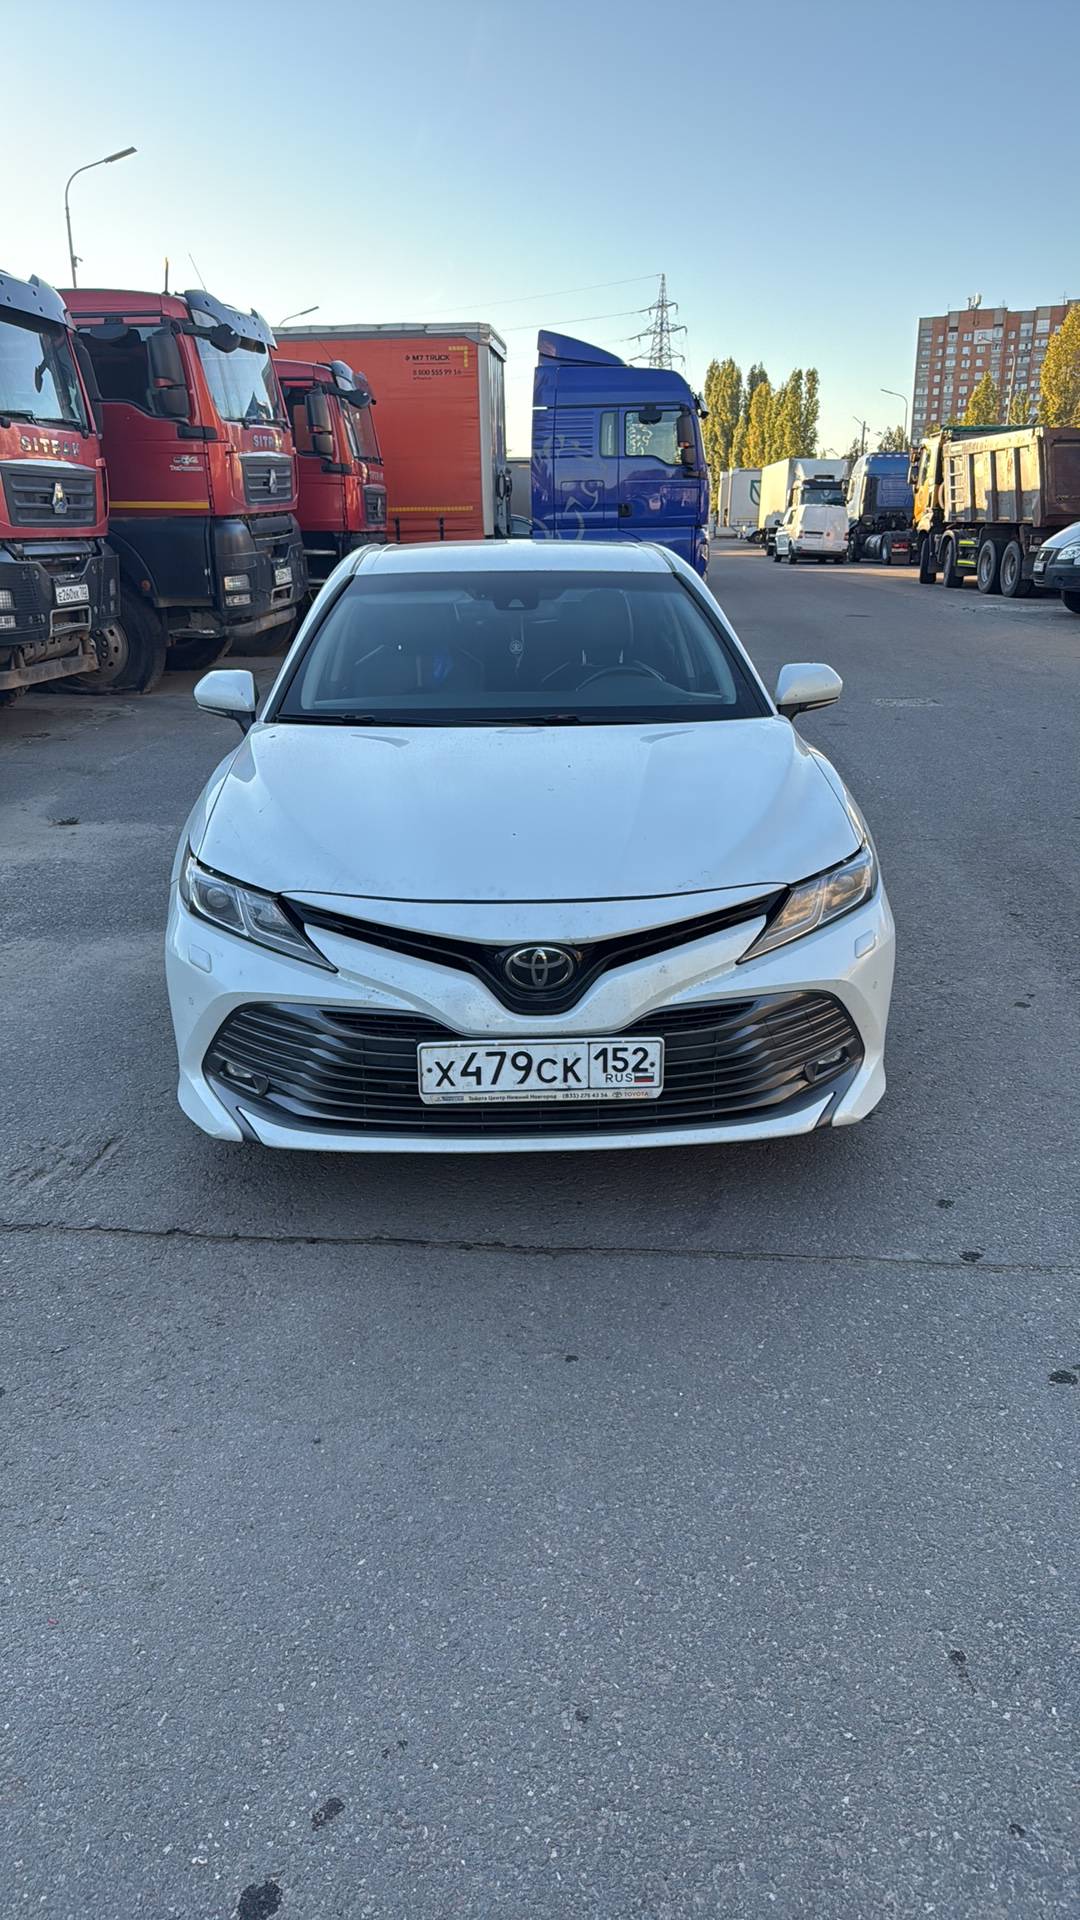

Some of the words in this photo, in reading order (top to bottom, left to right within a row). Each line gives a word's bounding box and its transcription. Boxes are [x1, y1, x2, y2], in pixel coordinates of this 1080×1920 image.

[20, 435, 80, 456] SITRAK
[435, 1050, 582, 1087] Х479СК
[593, 1046, 649, 1074] 152
[605, 1073, 633, 1083] RUS
